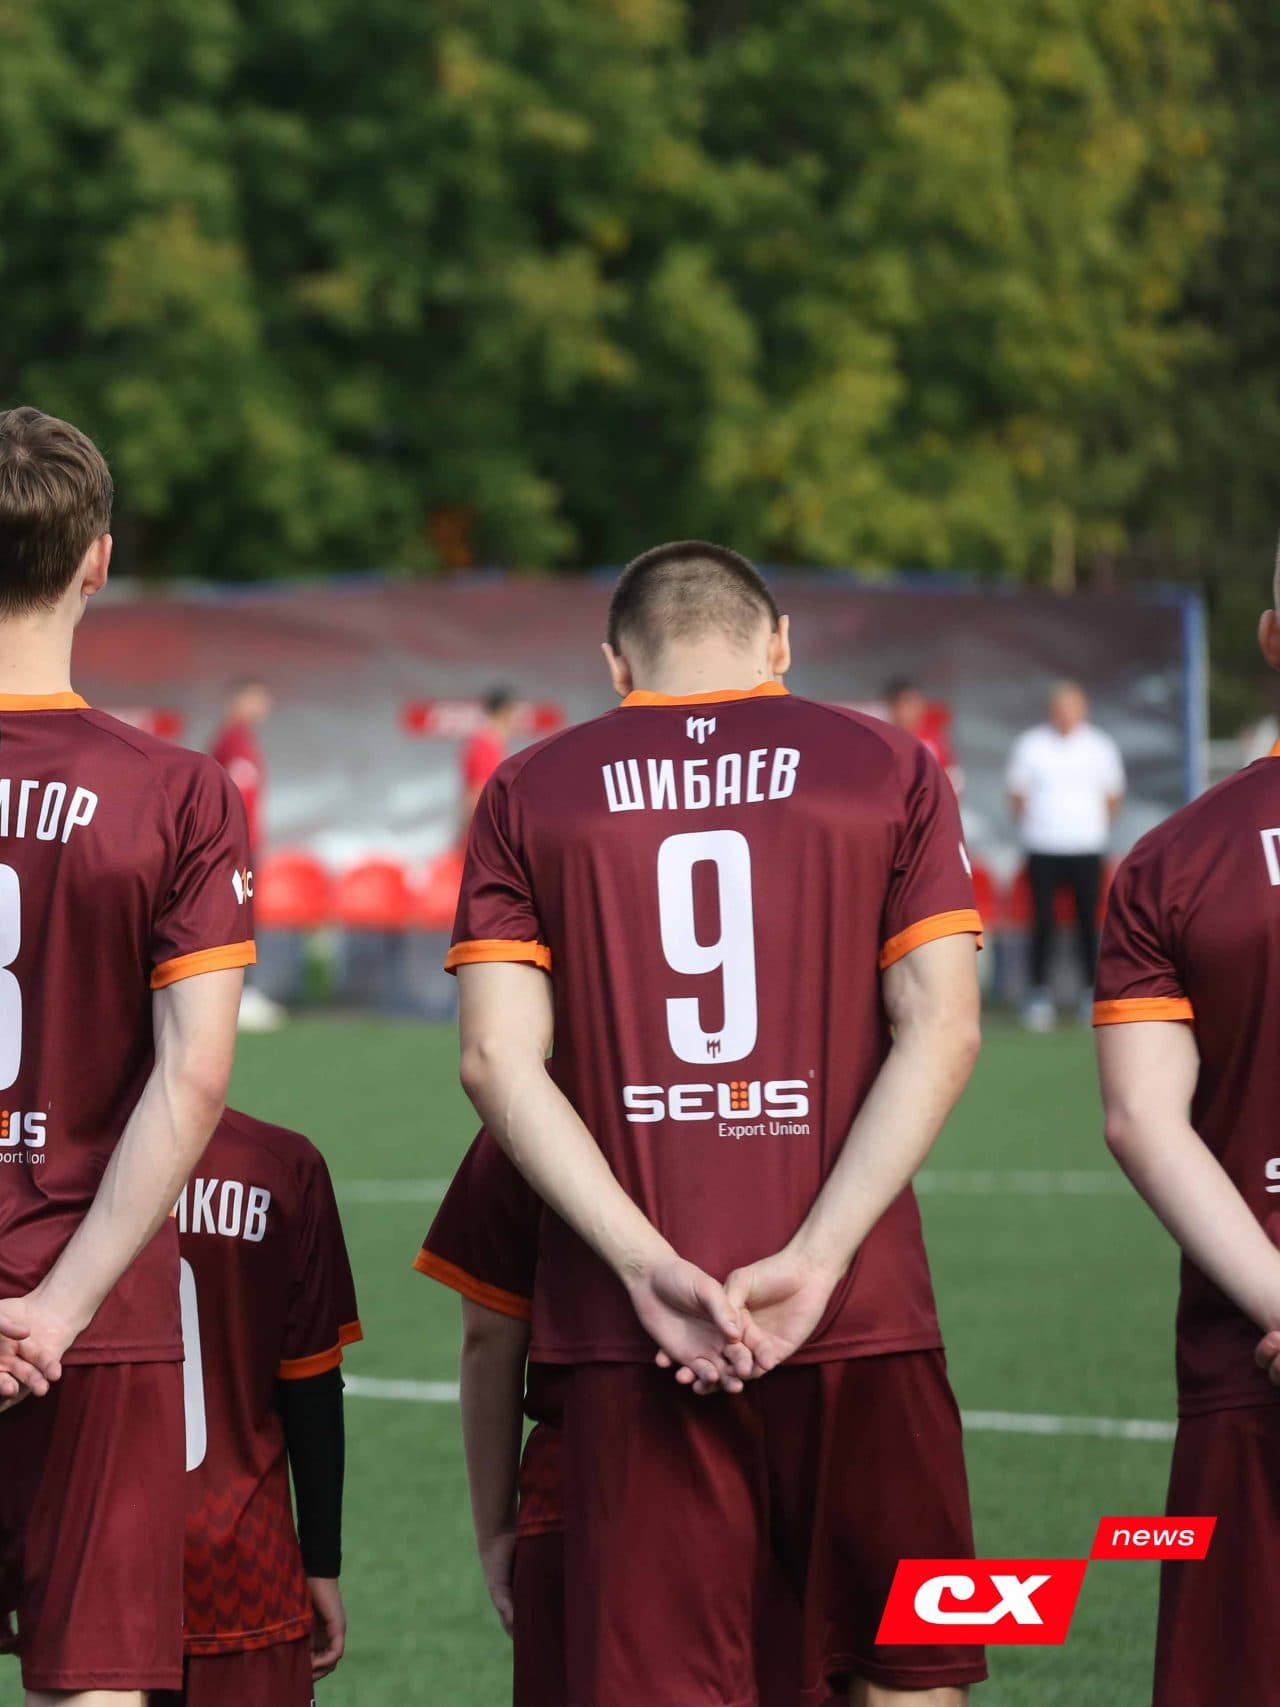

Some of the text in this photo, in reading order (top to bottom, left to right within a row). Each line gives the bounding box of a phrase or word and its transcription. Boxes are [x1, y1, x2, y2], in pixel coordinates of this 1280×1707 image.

[601, 747, 801, 813] ШИБАЕВ
[656, 829, 758, 1065] 9
[623, 1079, 809, 1123] SEUS
[718, 1121, 810, 1140] Export Union
